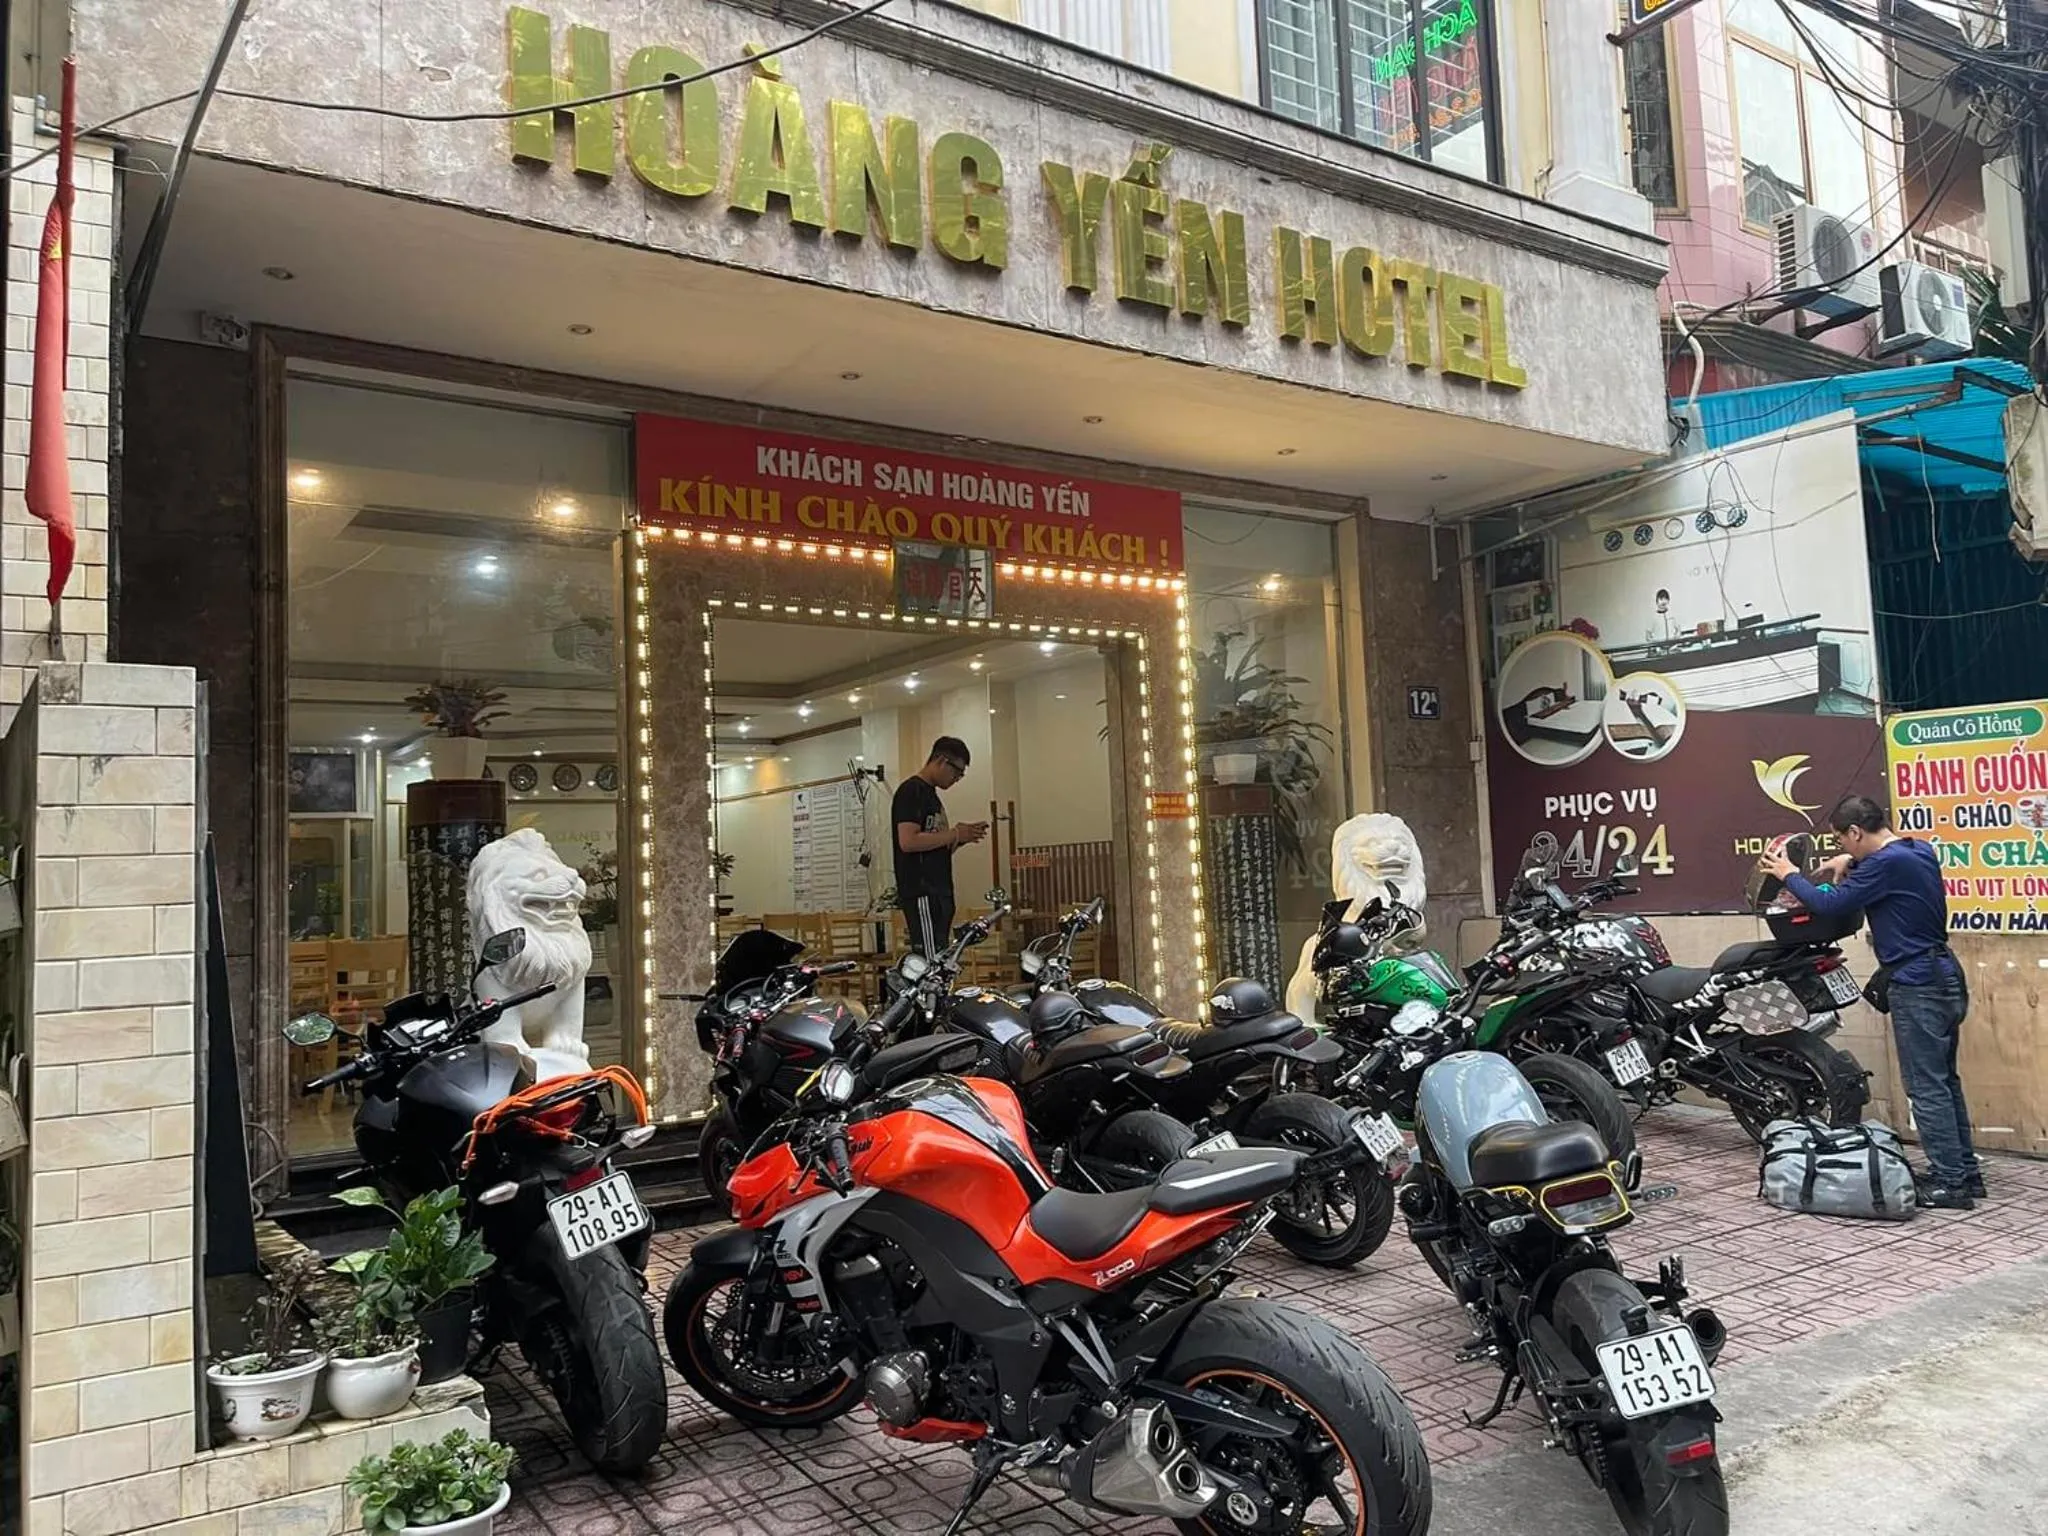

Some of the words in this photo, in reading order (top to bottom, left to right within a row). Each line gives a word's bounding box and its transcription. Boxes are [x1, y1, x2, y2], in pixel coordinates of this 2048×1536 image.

[508, 6, 1009, 272] HOÀNG
[1040, 142, 1250, 330] YẾN
[1273, 226, 1528, 390] HOTEL
[756, 445, 862, 487] KHÁCH
[874, 462, 934, 498] SẠN
[943, 472, 1033, 510] HOÀNG
[1041, 481, 1090, 517] YẾN
[658, 475, 782, 524] KÍNH
[797, 495, 918, 538] CHÀO
[931, 511, 1012, 549] QUÝ
[1022, 523, 1145, 565] KHÁCH
[1907, 721, 1951, 743] Quán
[1953, 717, 1976, 737] Cô
[1978, 713, 2022, 734] Hồng
[1896, 754, 1967, 798] BÁNH
[1974, 741, 2048, 794] CUỐN
[1544, 791, 1614, 823] PHỤC
[1620, 787, 1657, 818] VỤ
[1899, 803, 1933, 831] XÔI
[1954, 800, 2013, 828] CHÁO
[1981, 830, 2048, 867] CHẢ
[1976, 878, 2005, 900] VỊT
[2012, 874, 2048, 900] LỘN
[1950, 907, 2002, 930] MÓN
[562, 1181, 622, 1225] 29-A1
[567, 1203, 639, 1252] 108.95
[1613, 1333, 1686, 1376] 29-A1
[1621, 1365, 1710, 1411] 153.52
